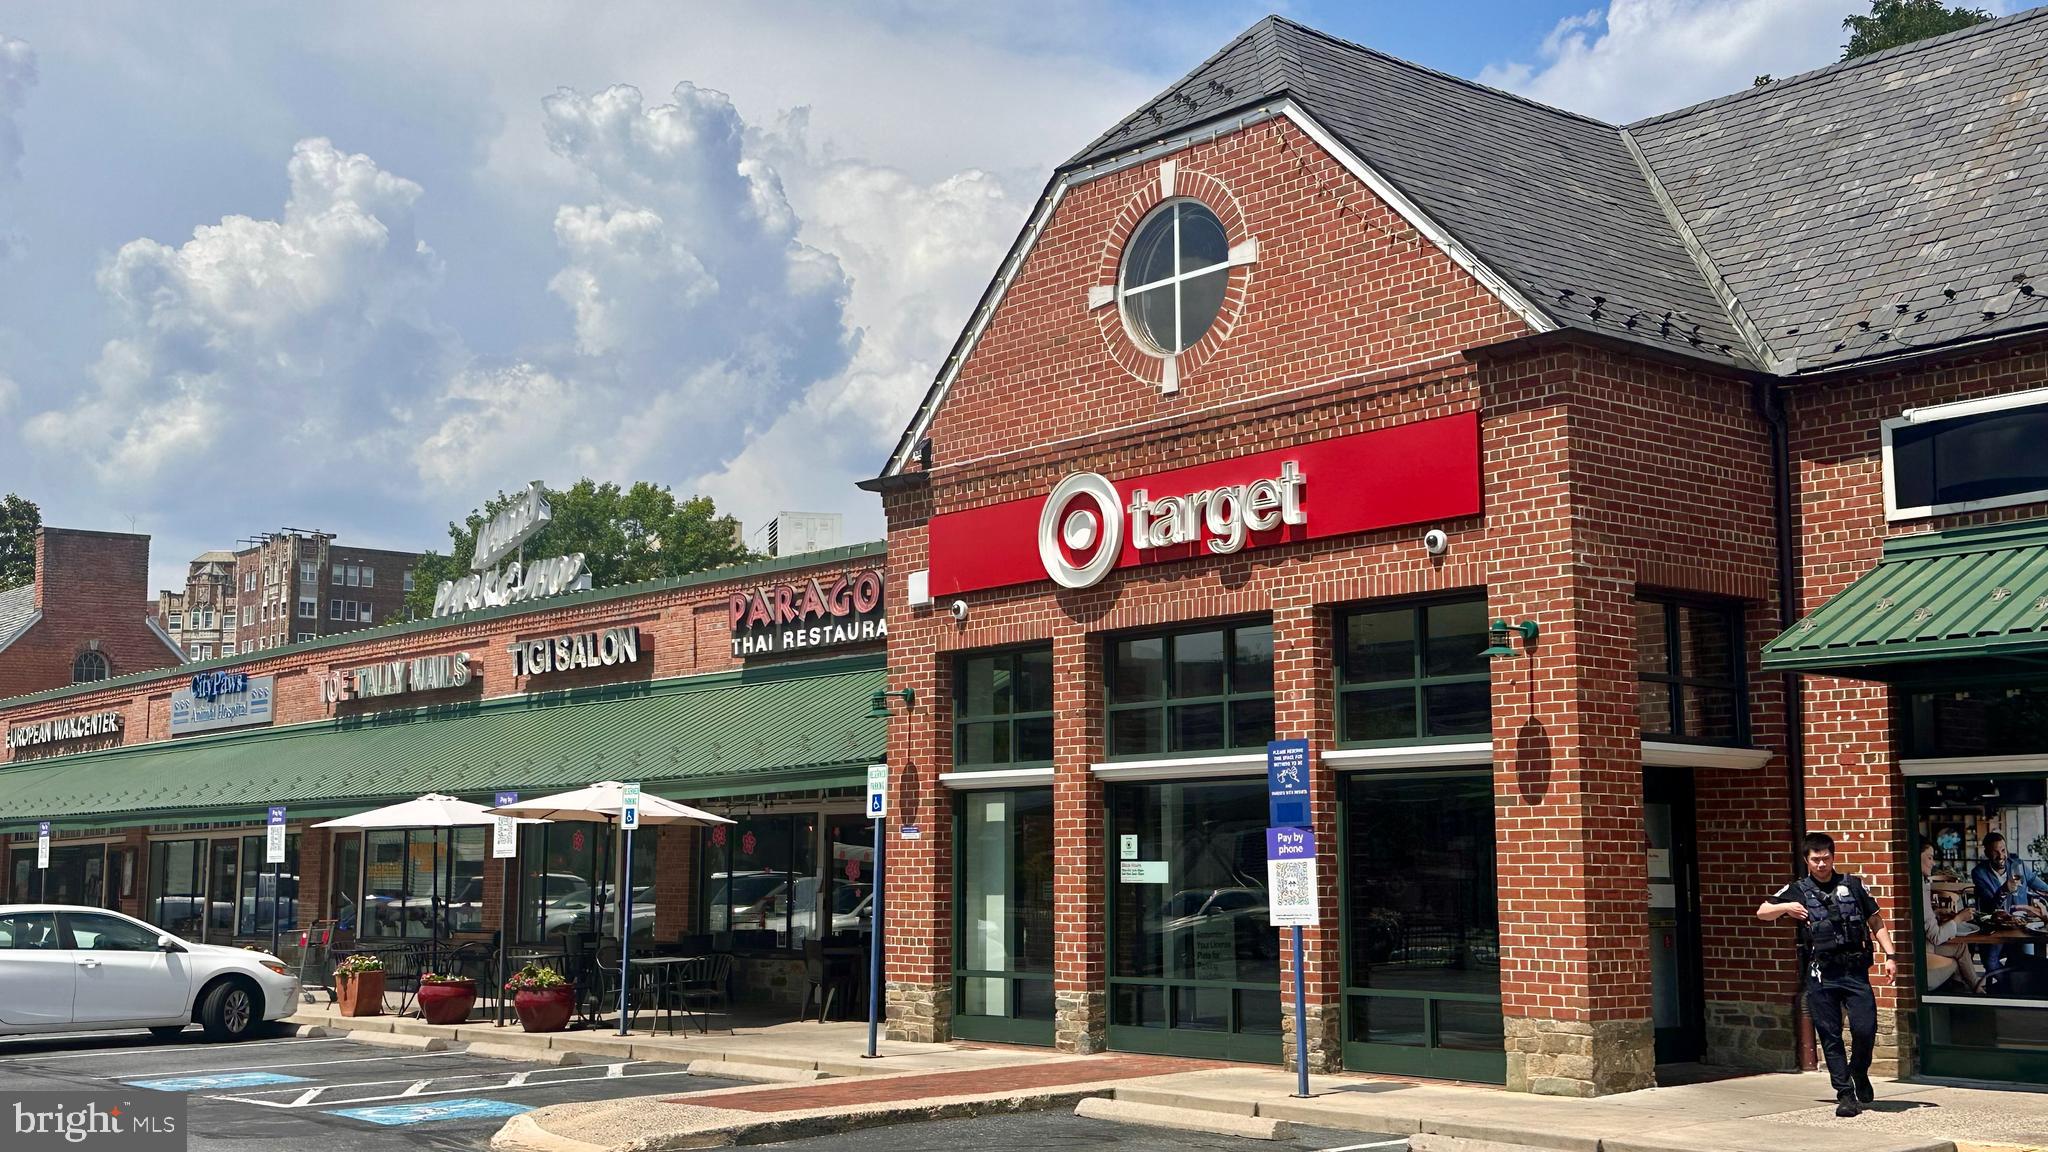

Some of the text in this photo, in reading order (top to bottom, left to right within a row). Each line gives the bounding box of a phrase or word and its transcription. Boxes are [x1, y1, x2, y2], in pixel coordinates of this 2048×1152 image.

[1127, 460, 1307, 554] target
[507, 626, 639, 676] TIGI SALON
[732, 619, 888, 655] THAI RESTAURA
[411, 652, 471, 692] NAILS
[218, 701, 248, 722] Hospital
[6, 720, 52, 748] EUROPEAN
[78, 712, 119, 737] CENTER
[1277, 832, 1304, 845] Pay by
[1279, 845, 1303, 857] phone
